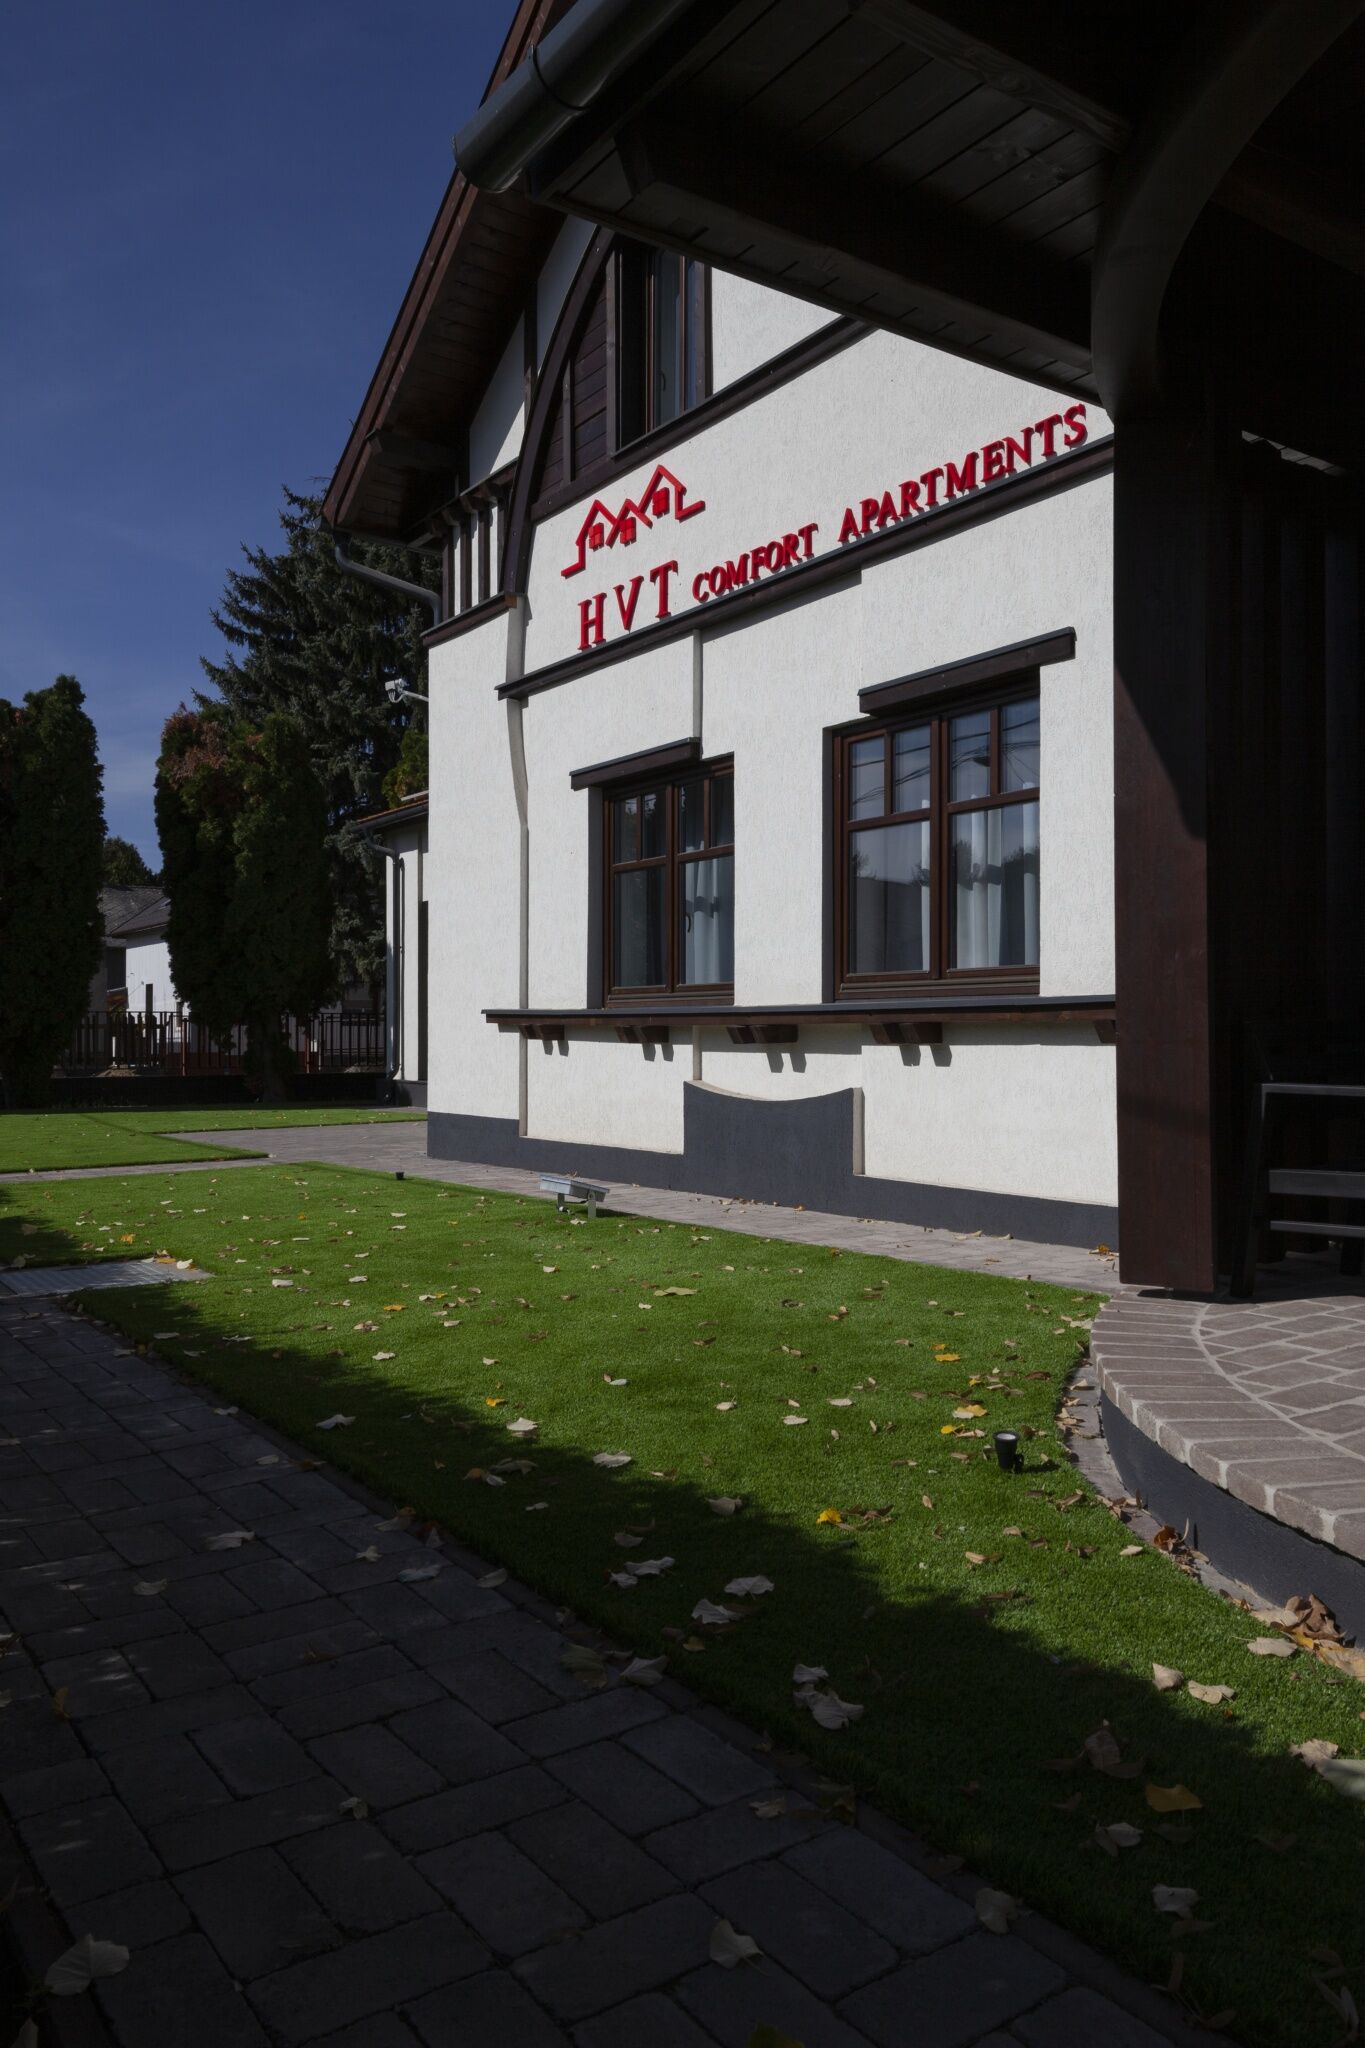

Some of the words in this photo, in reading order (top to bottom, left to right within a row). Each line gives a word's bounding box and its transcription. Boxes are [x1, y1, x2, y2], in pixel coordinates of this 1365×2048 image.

[578, 559, 679, 650] HVT
[692, 523, 818, 602] COMFORT
[838, 403, 1088, 543] APARTMENTS
